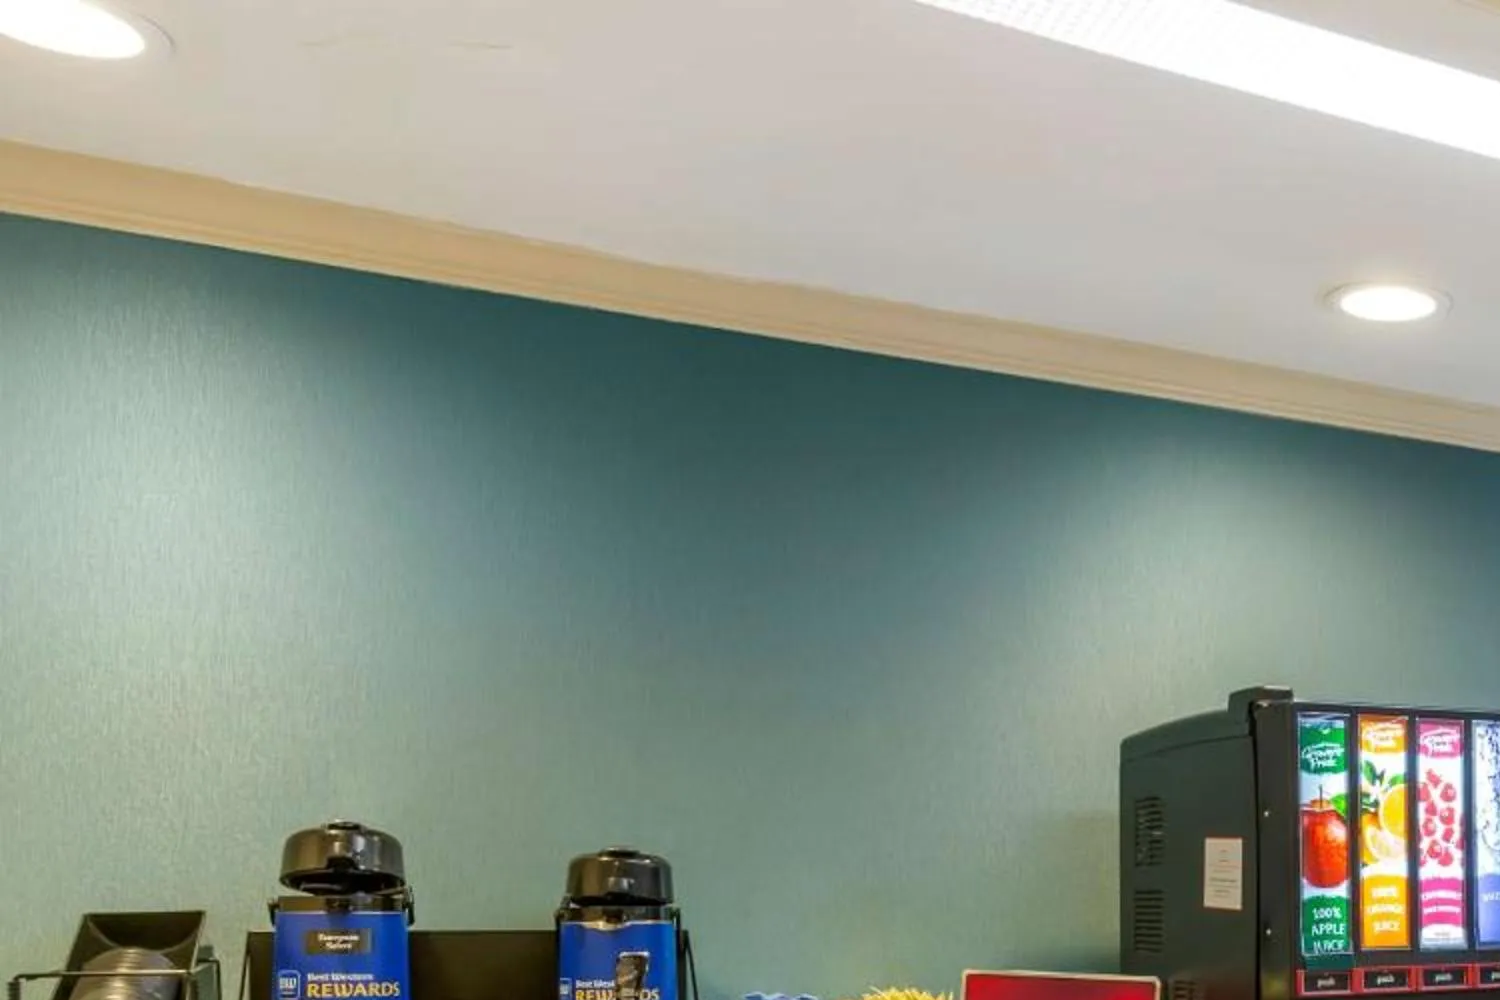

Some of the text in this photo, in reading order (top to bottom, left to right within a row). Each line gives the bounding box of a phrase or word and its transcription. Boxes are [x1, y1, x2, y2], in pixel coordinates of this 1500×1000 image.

[1312, 906, 1342, 919] 100%
[1311, 922, 1345, 936] APPLE
[307, 981, 400, 998] REWARDS
